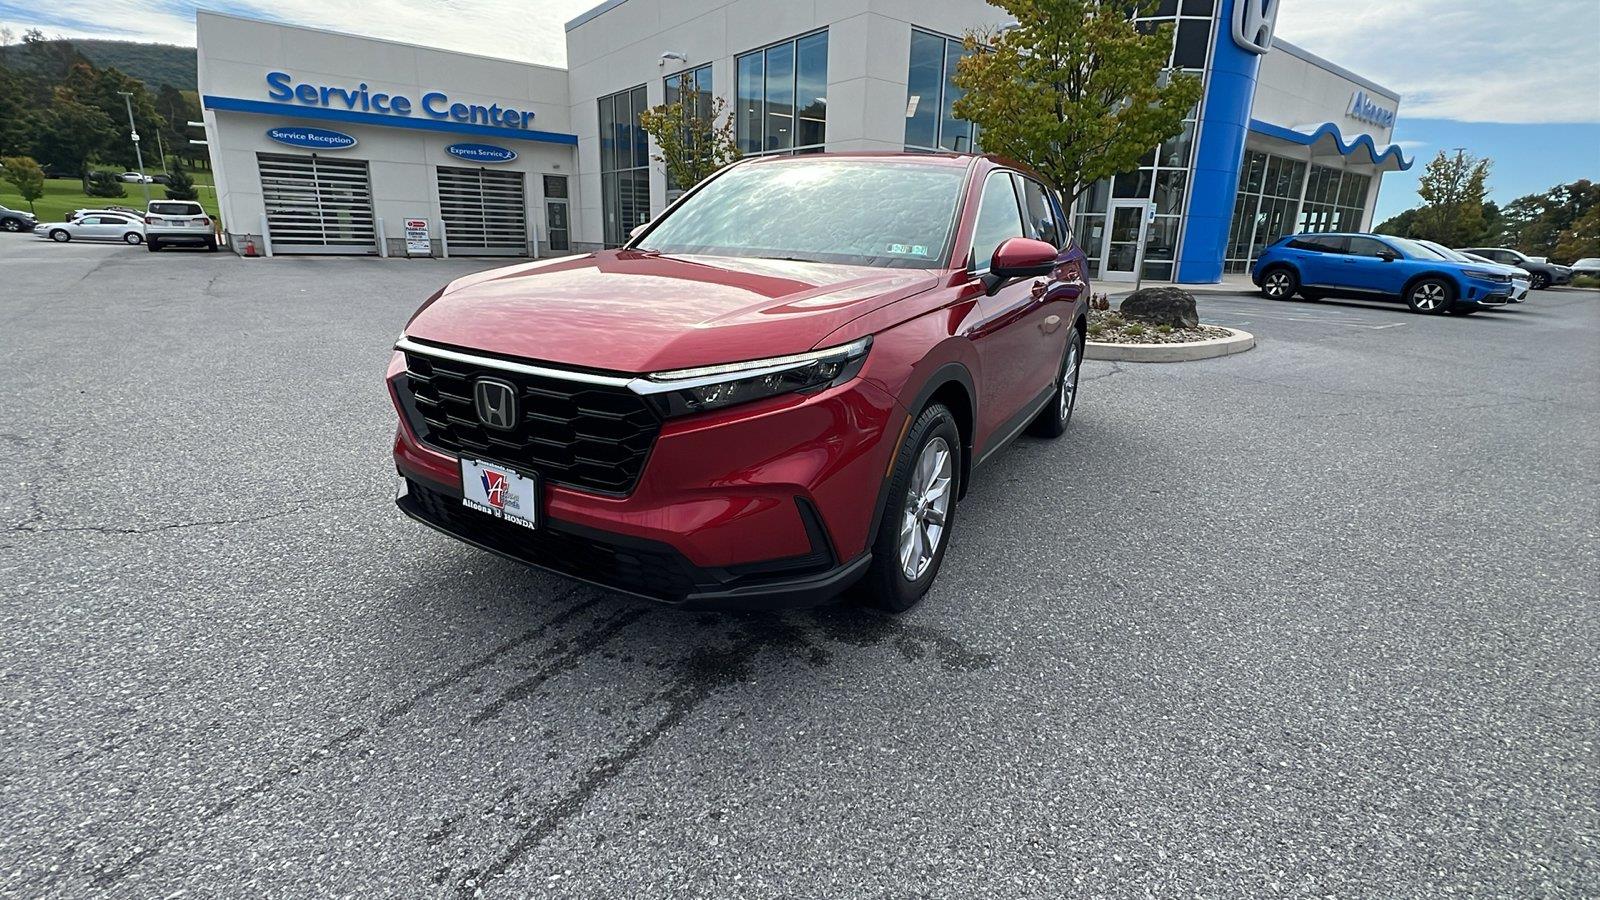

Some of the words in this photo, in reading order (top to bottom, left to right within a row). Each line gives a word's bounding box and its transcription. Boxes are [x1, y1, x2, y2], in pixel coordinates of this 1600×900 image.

[266, 71, 412, 115] Service
[421, 92, 536, 129] Center
[272, 130, 306, 142] Service
[308, 133, 352, 145] Reception
[450, 146, 477, 157] Express
[478, 148, 503, 158] Service
[462, 498, 492, 515] Altoona
[504, 513, 535, 530] HONDA
